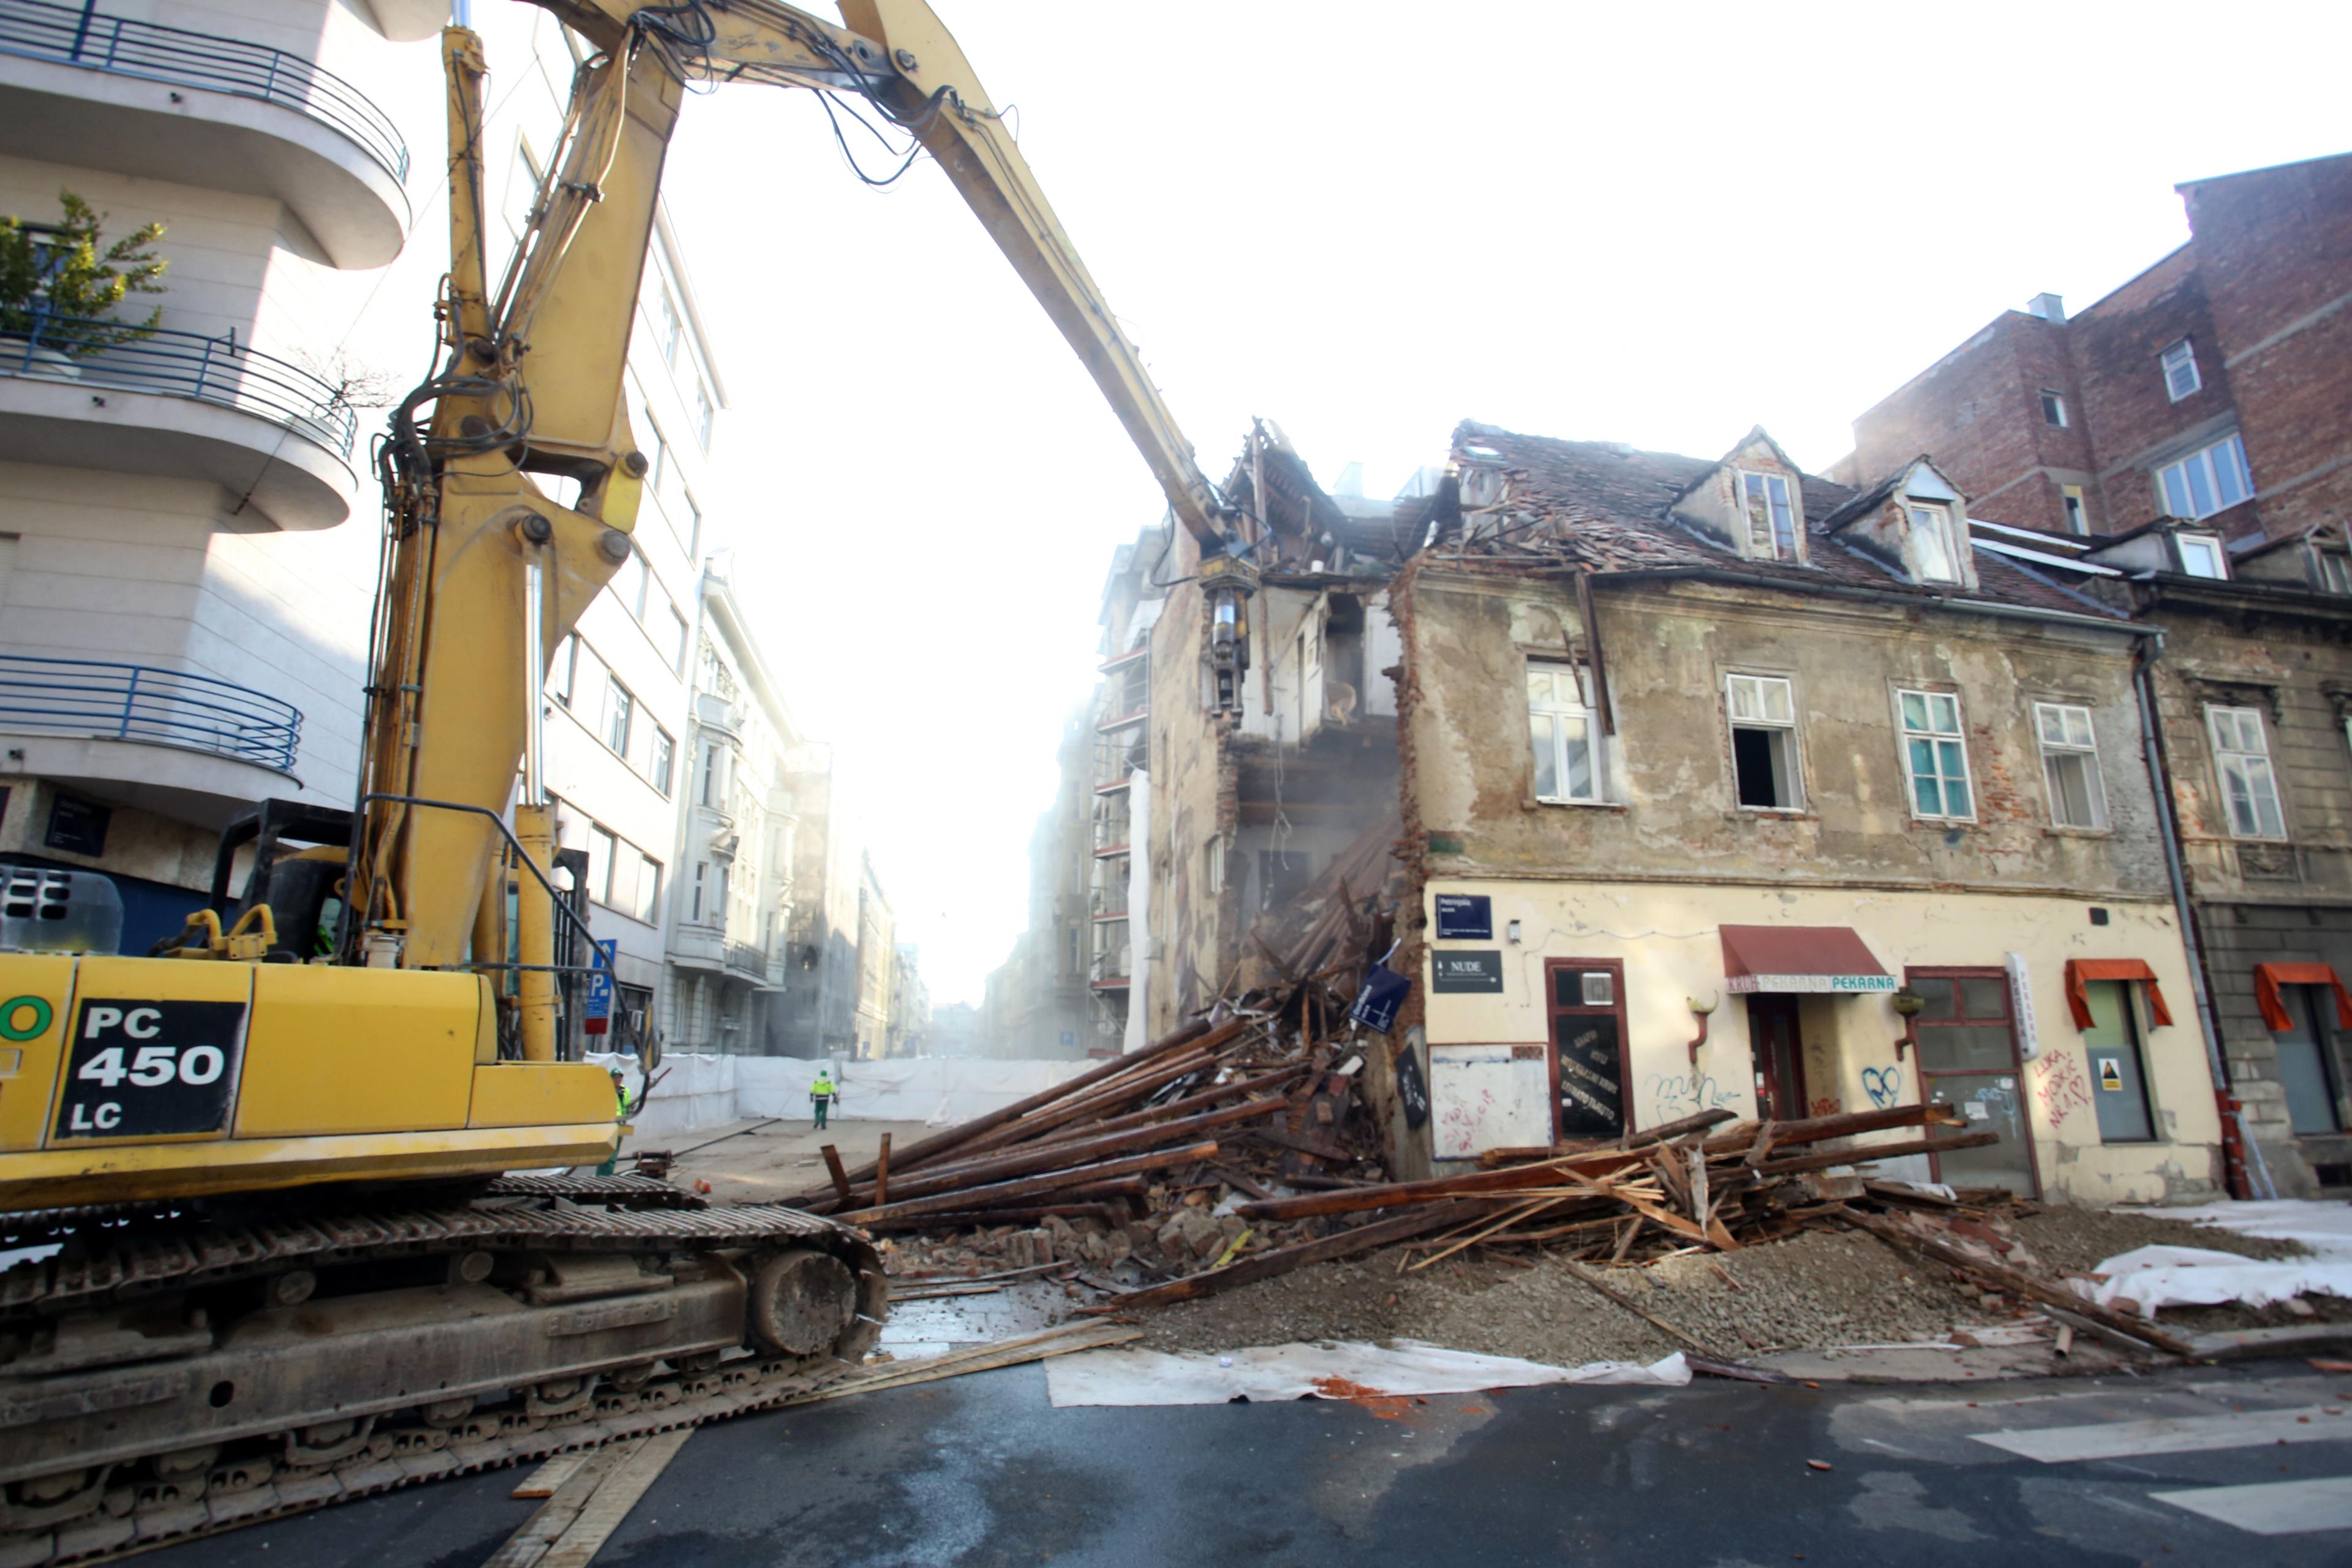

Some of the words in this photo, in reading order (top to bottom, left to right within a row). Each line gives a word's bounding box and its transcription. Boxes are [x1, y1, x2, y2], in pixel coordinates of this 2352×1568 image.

[1450, 961, 1482, 973] NUDE
[591, 974, 605, 997] P
[1833, 977, 1894, 989] PEKARNA
[84, 1007, 162, 1039] PC
[78, 1045, 225, 1087] 450
[70, 1102, 122, 1131] LC
